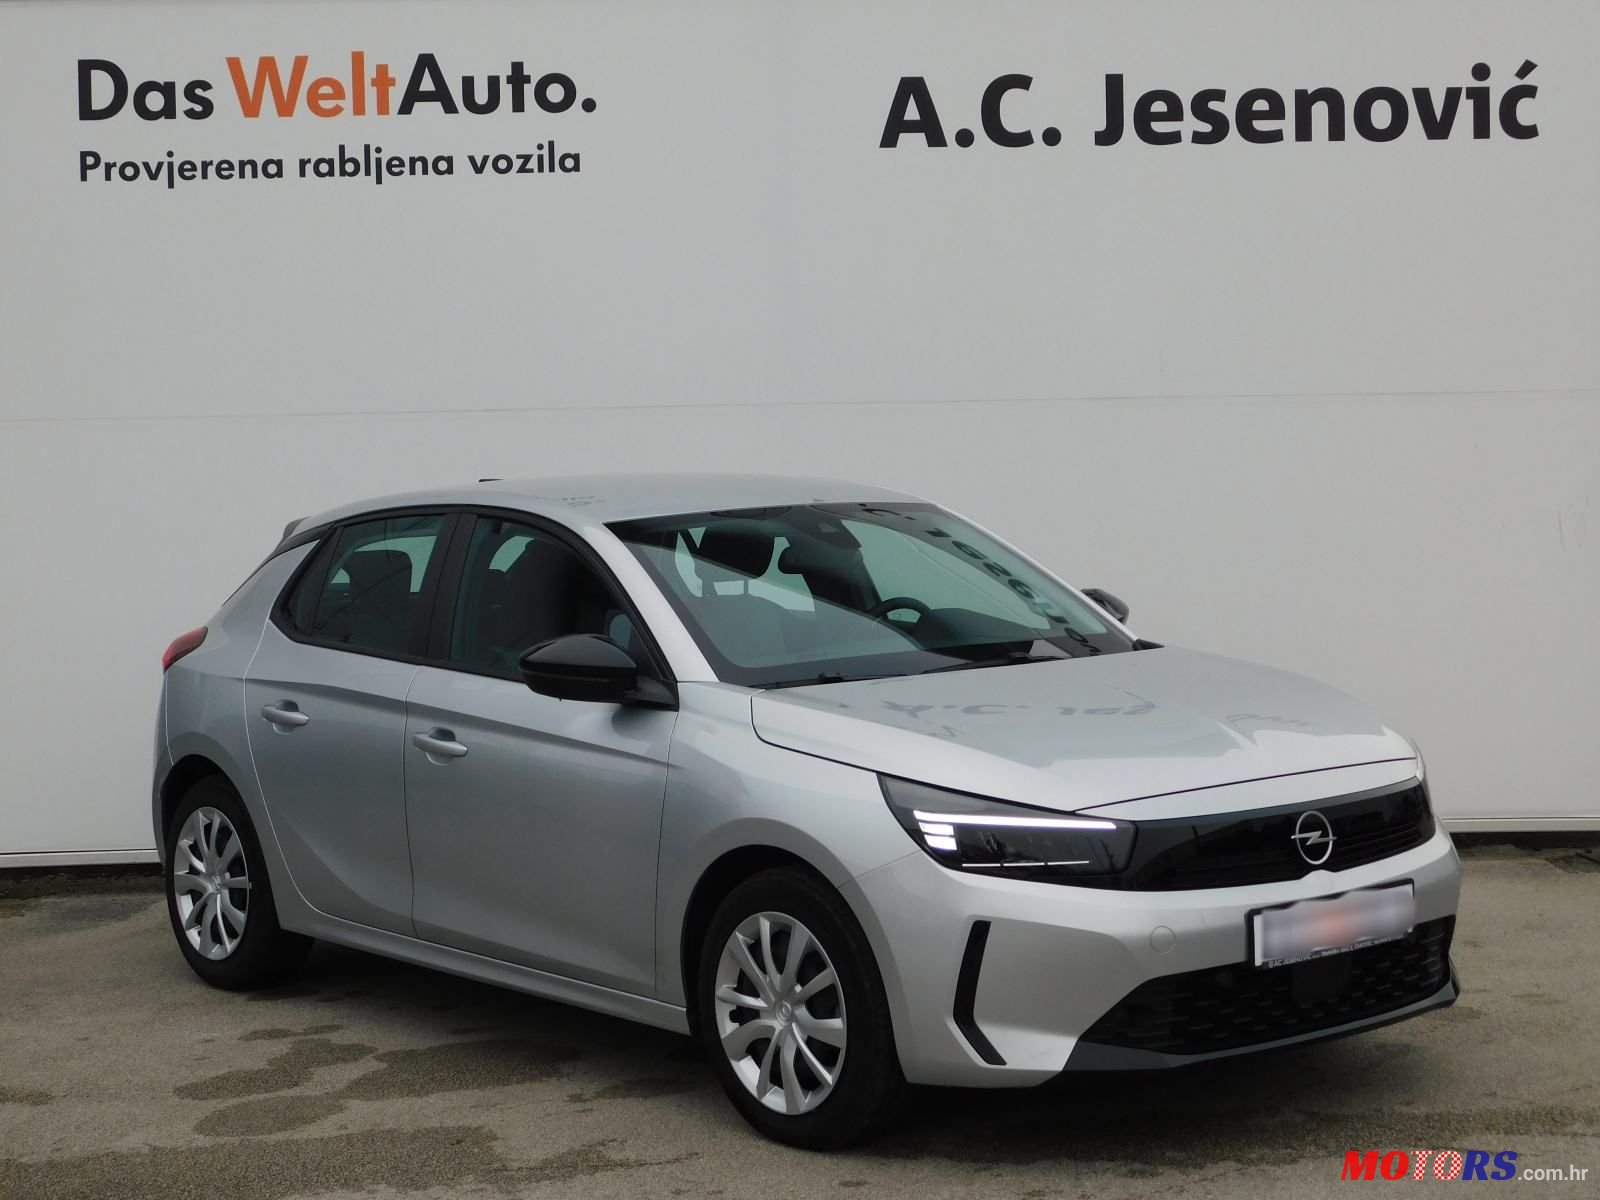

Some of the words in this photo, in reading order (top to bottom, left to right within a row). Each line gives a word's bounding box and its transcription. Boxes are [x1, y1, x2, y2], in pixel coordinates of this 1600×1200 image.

[78, 59, 215, 122] Das
[226, 50, 597, 119] WeltAuto.
[880, 73, 1062, 149] A.C.
[1094, 59, 1540, 147] Jesenović
[79, 150, 284, 189] Provjerena
[298, 143, 454, 185] rabljena
[467, 140, 581, 175] vozila
